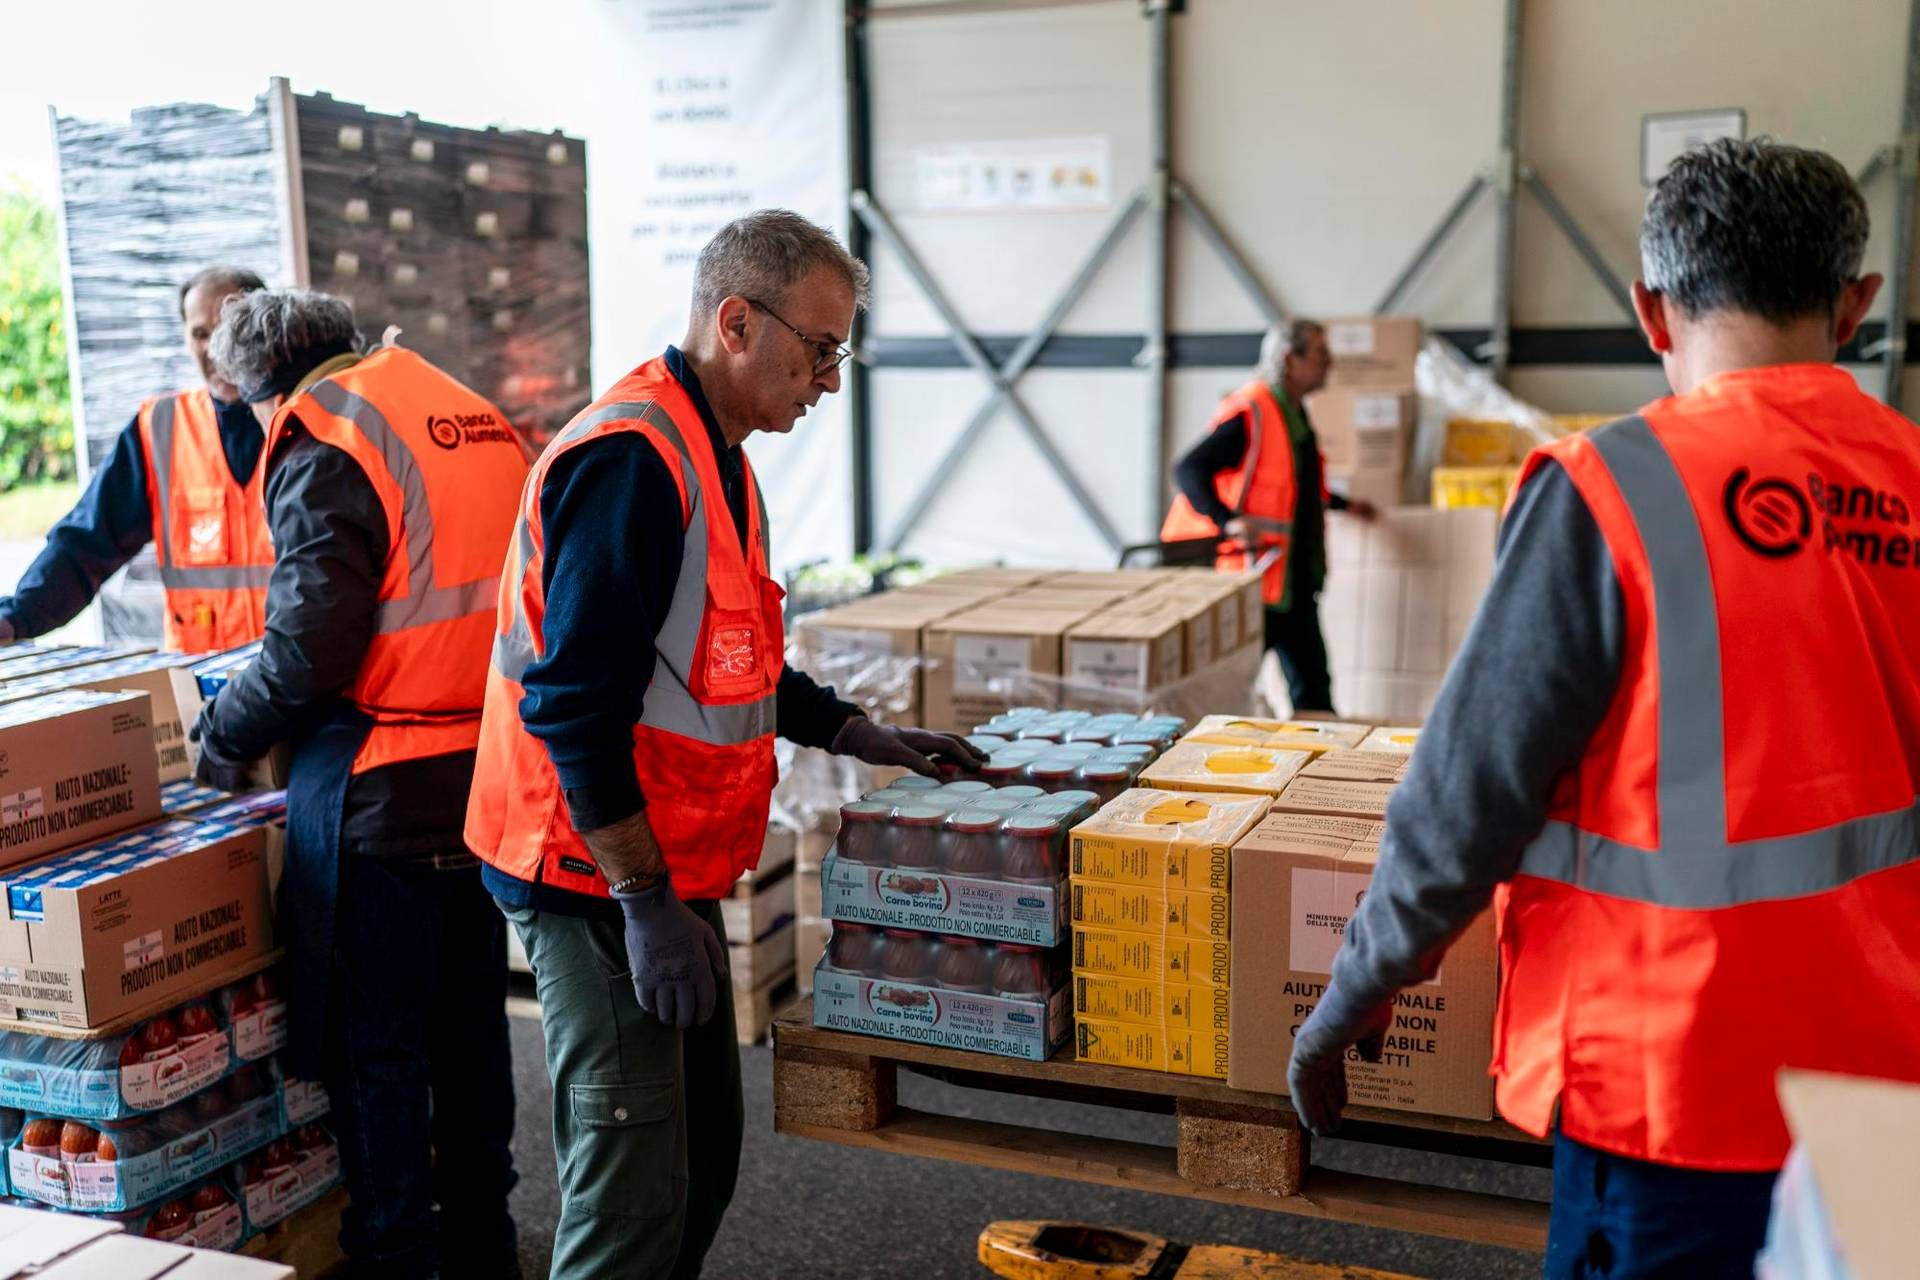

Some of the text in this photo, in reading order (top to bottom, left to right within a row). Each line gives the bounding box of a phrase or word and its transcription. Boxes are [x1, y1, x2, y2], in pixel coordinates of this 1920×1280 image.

[55, 776, 81, 803] AIUTO
[0, 790, 134, 850] PRODOTTO NON COMMERCIABILE
[98, 888, 122, 905] LATTE
[962, 887, 970, 896] 12
[885, 895, 911, 907] Carne
[912, 898, 942, 911] bovina
[834, 903, 858, 918] AIUTO
[860, 907, 903, 924] NAZIONALE
[909, 914, 953, 930] PRODOTTO
[954, 918, 972, 933] NON
[973, 920, 1041, 943] COMMERCIABILE
[1306, 912, 1348, 923] MINISTERO
[1306, 919, 1347, 929] DELLA SOV
[173, 916, 198, 945] AIUTO
[120, 959, 166, 997] PRODOTTO
[166, 952, 184, 979] NON
[184, 926, 247, 970] COMMERCIABILE
[1282, 981, 1327, 998] AIUT
[876, 1006, 901, 1018] Carne
[903, 1009, 933, 1023] bovina
[1396, 1014, 1437, 1032] NON
[827, 1013, 850, 1028] AIUTO
[851, 1017, 895, 1035] NAZIONALE
[900, 1024, 944, 1042] PRODOTTO
[945, 1032, 962, 1046] NON
[964, 1035, 1031, 1057] COMMERCIABILE
